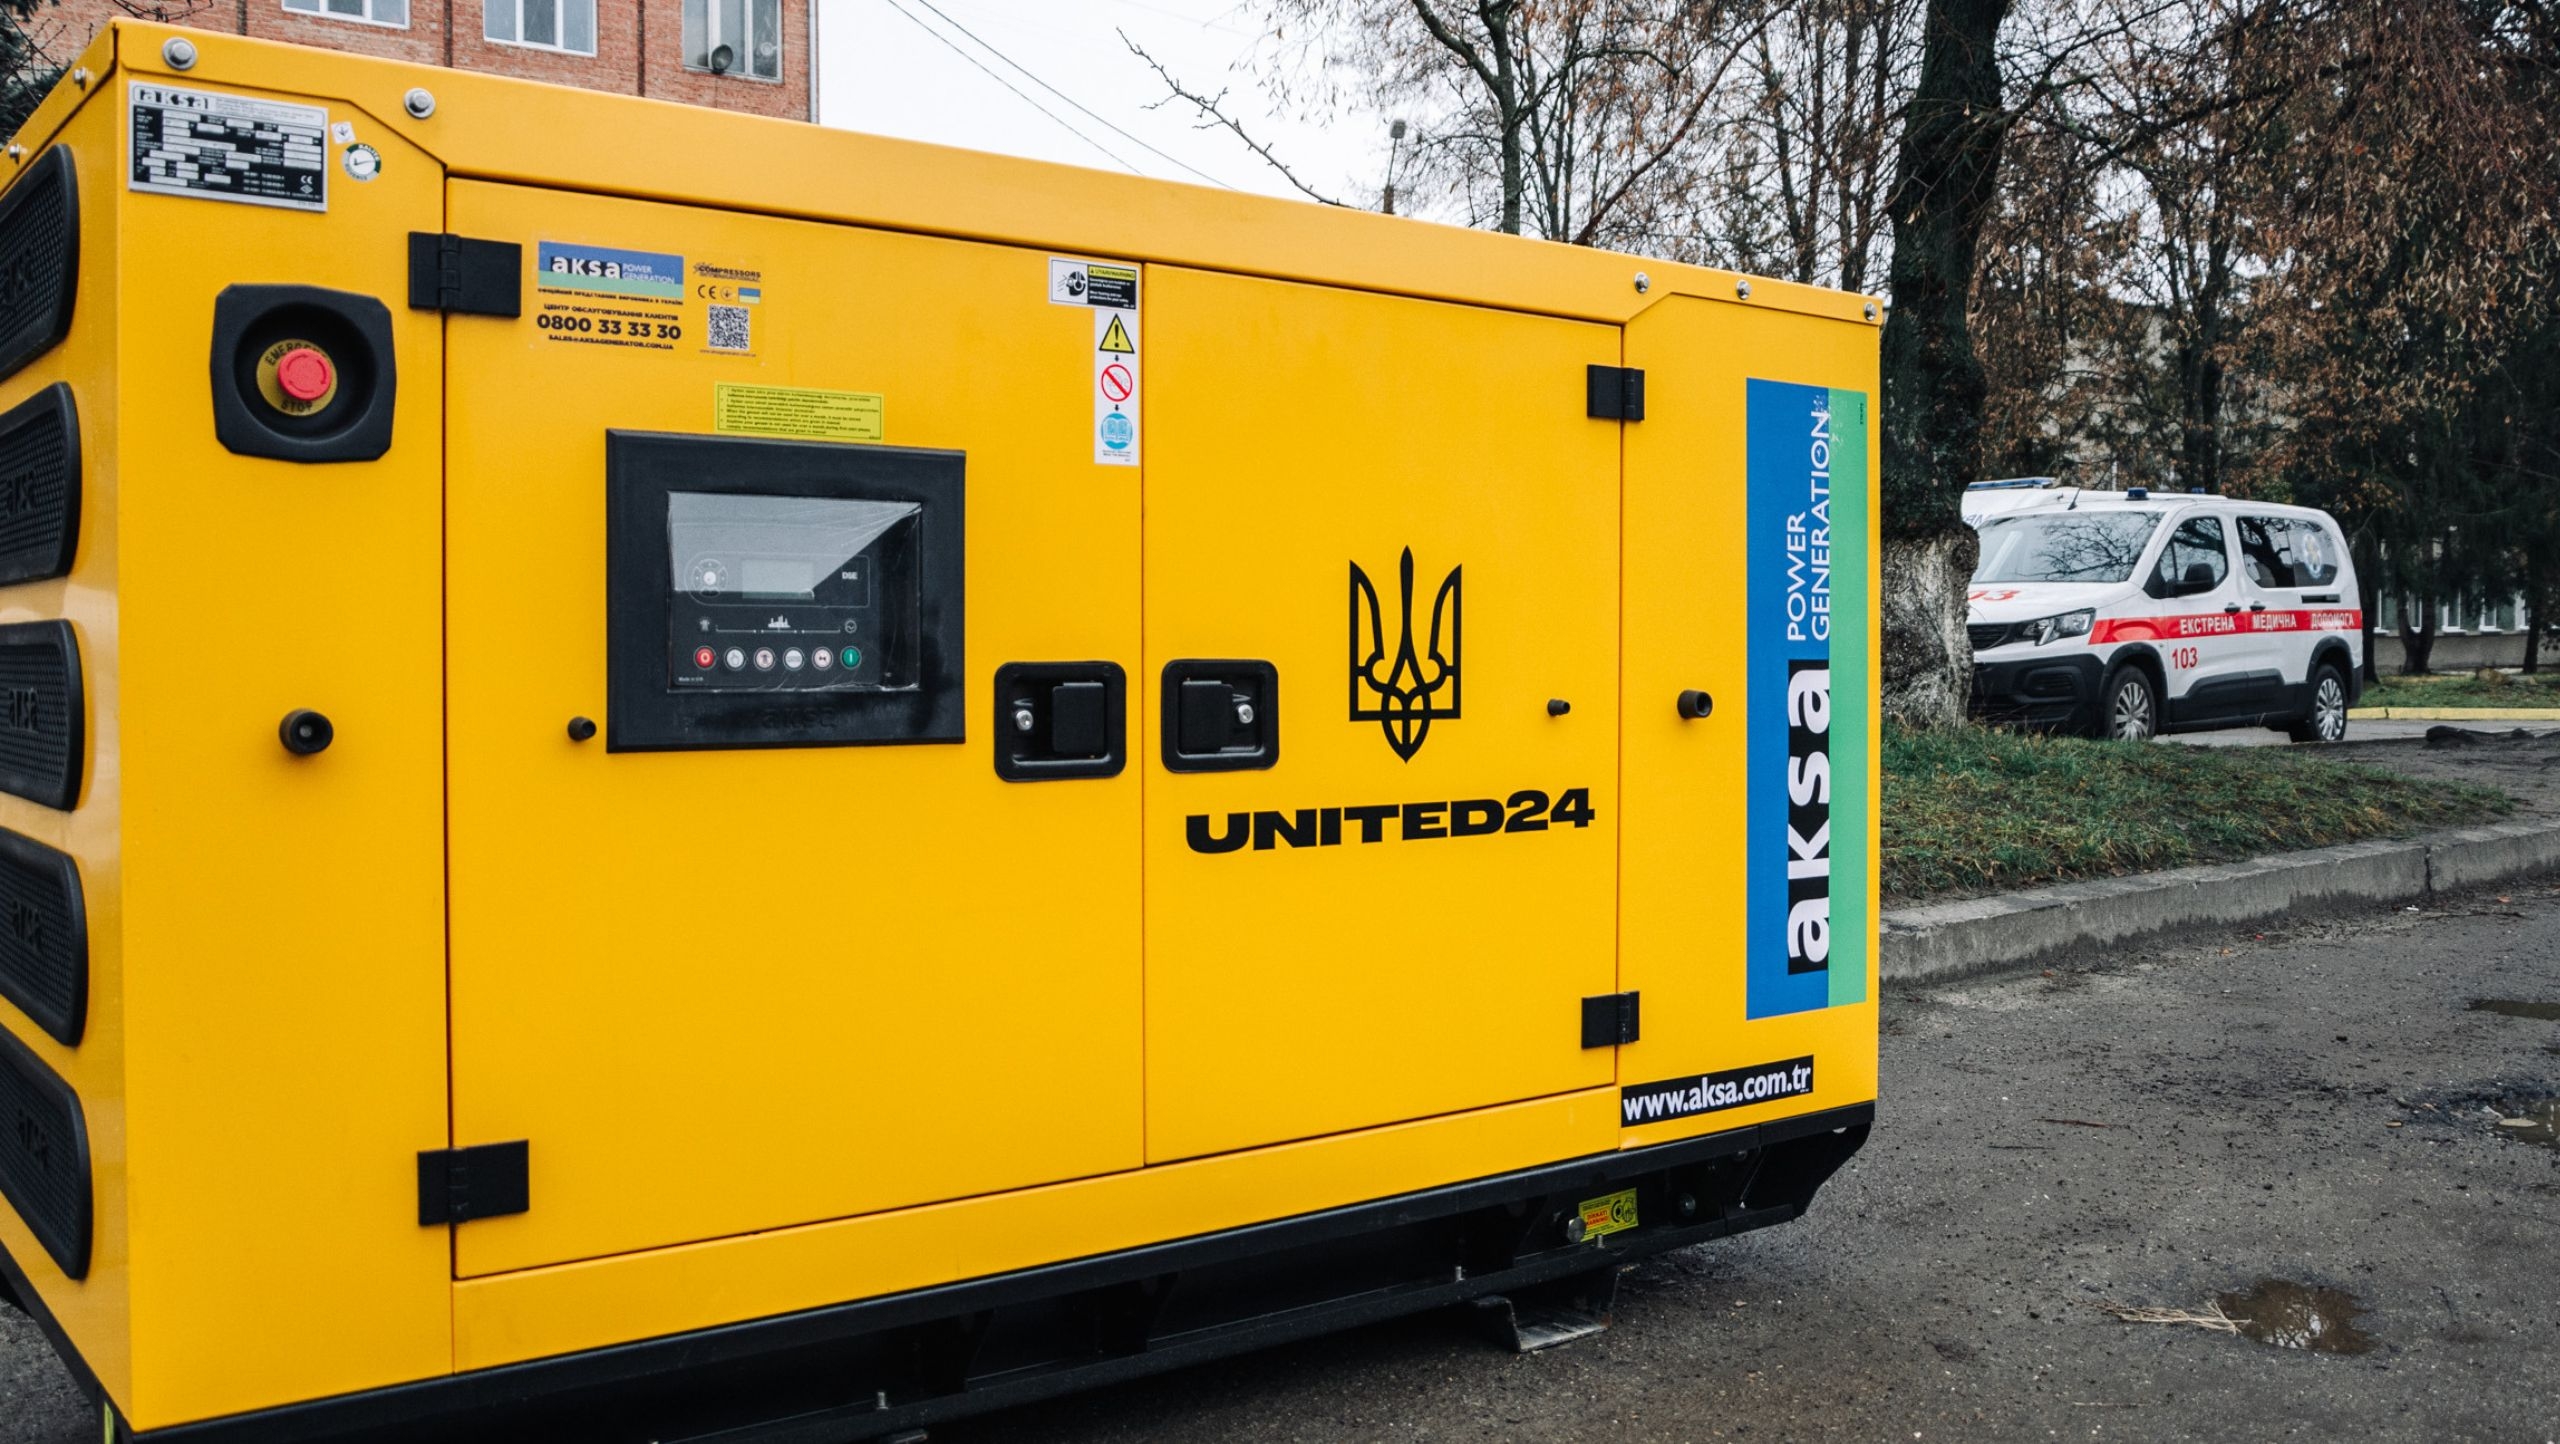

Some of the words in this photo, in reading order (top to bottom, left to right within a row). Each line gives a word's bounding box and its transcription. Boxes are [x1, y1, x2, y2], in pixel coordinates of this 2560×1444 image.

[551, 256, 622, 280] aksa
[622, 262, 652, 274] POWER
[537, 313, 592, 333] 0800
[598, 318, 622, 336] 33
[628, 321, 651, 338] 33
[657, 324, 682, 340] 30
[544, 303, 570, 311] ЦЕНТР
[1810, 410, 1830, 641] GENERATION
[1787, 511, 1806, 641] POWER
[2180, 615, 2236, 635] ЕКСТРЕНА
[2252, 613, 2297, 631] МЕДИЧНА
[2171, 646, 2198, 670] 103
[1185, 787, 1596, 855] UNITED24
[1787, 667, 1830, 964] aksa
[1622, 1063, 1812, 1122] www.aksa.com.tr
